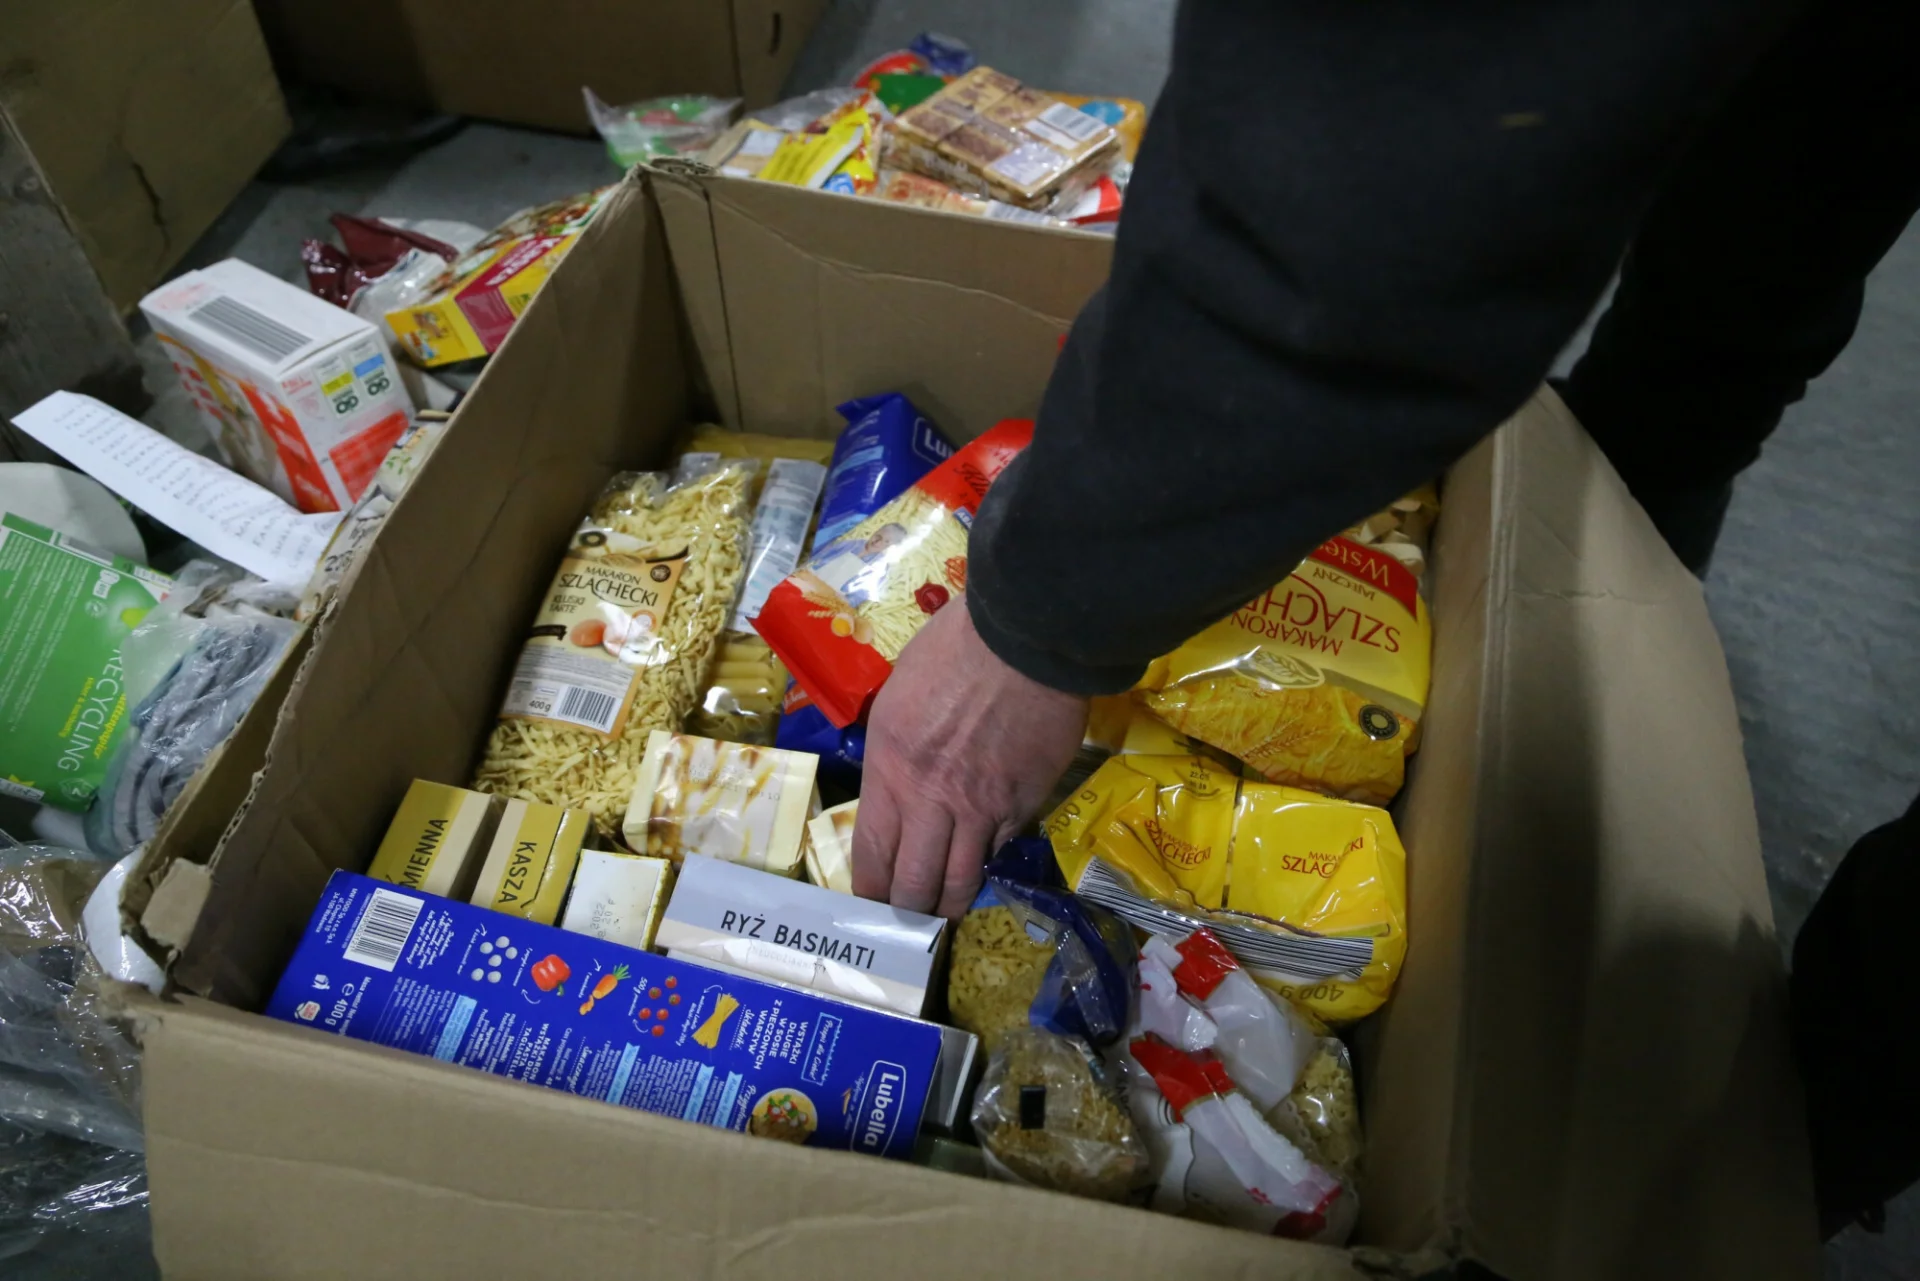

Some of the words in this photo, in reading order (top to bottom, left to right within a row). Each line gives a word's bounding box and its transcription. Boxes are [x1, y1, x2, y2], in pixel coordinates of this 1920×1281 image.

[559, 573, 660, 607] SZLACHECKI
[585, 566, 642, 585] MAKARON
[1230, 611, 1344, 656] MAKARON
[528, 699, 544, 709] 400
[544, 703, 551, 712] g
[1048, 802, 1081, 836] 400
[1080, 789, 1099, 805] g
[497, 841, 538, 904] KASZA
[720, 908, 768, 939] RYŻ
[773, 926, 877, 971] BASMATI
[331, 998, 348, 1018] 400
[1279, 984, 1296, 1001] g
[1301, 984, 1345, 1002] 400
[748, 1010, 768, 1054] WARZYW
[754, 1007, 780, 1070] PIECZONYCH
[778, 1018, 788, 1028] W
[779, 1022, 797, 1058] DŁUGIE
[518, 1042, 533, 1066] PASTA
[529, 1037, 551, 1080] MAKARON
[768, 1029, 784, 1057] SOSIE
[789, 1022, 808, 1064] WSTĄŻKI
[865, 1072, 899, 1144] Lubella
